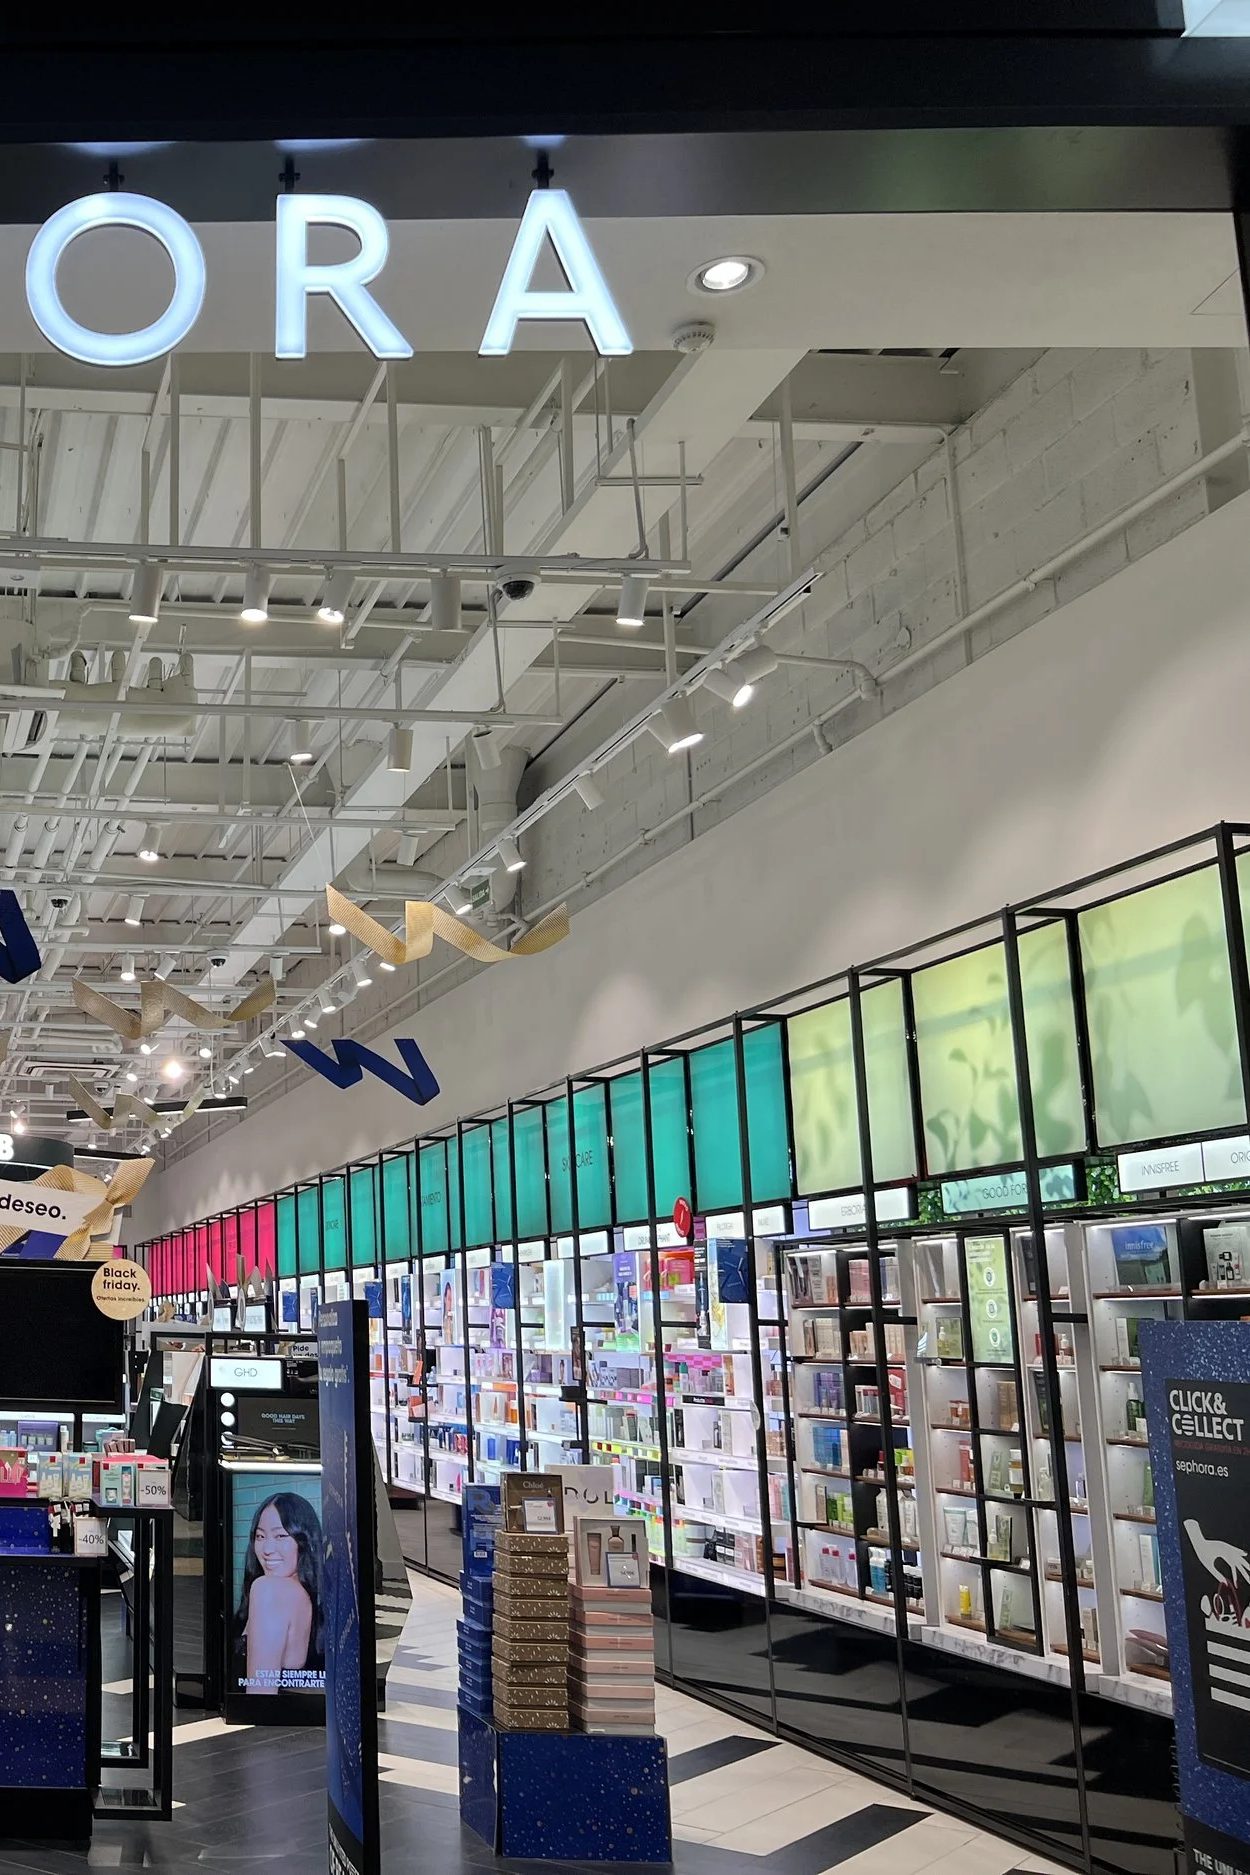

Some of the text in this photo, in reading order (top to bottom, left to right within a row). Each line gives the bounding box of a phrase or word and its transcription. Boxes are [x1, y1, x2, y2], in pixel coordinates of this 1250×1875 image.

[1141, 1160, 1180, 1176] INNISFREE
[981, 1184, 1009, 1200] GOOD
[103, 1267, 137, 1279] Black
[103, 1279, 141, 1292] friday.
[233, 1367, 258, 1378] GHD
[1170, 1389, 1228, 1415] CLICK&
[1171, 1413, 1244, 1442] COLLECT
[1175, 1459, 1230, 1478] sephora.es
[140, 1485, 167, 1496] -50%
[522, 1480, 544, 1489] Chloé
[78, 1534, 105, 1545] -40%
[255, 1669, 281, 1678] ESTAR
[281, 1670, 318, 1679] SIEMPRE
[237, 1677, 326, 1688] PARA ENCONTRARTE
[1193, 1848, 1214, 1871] THE
